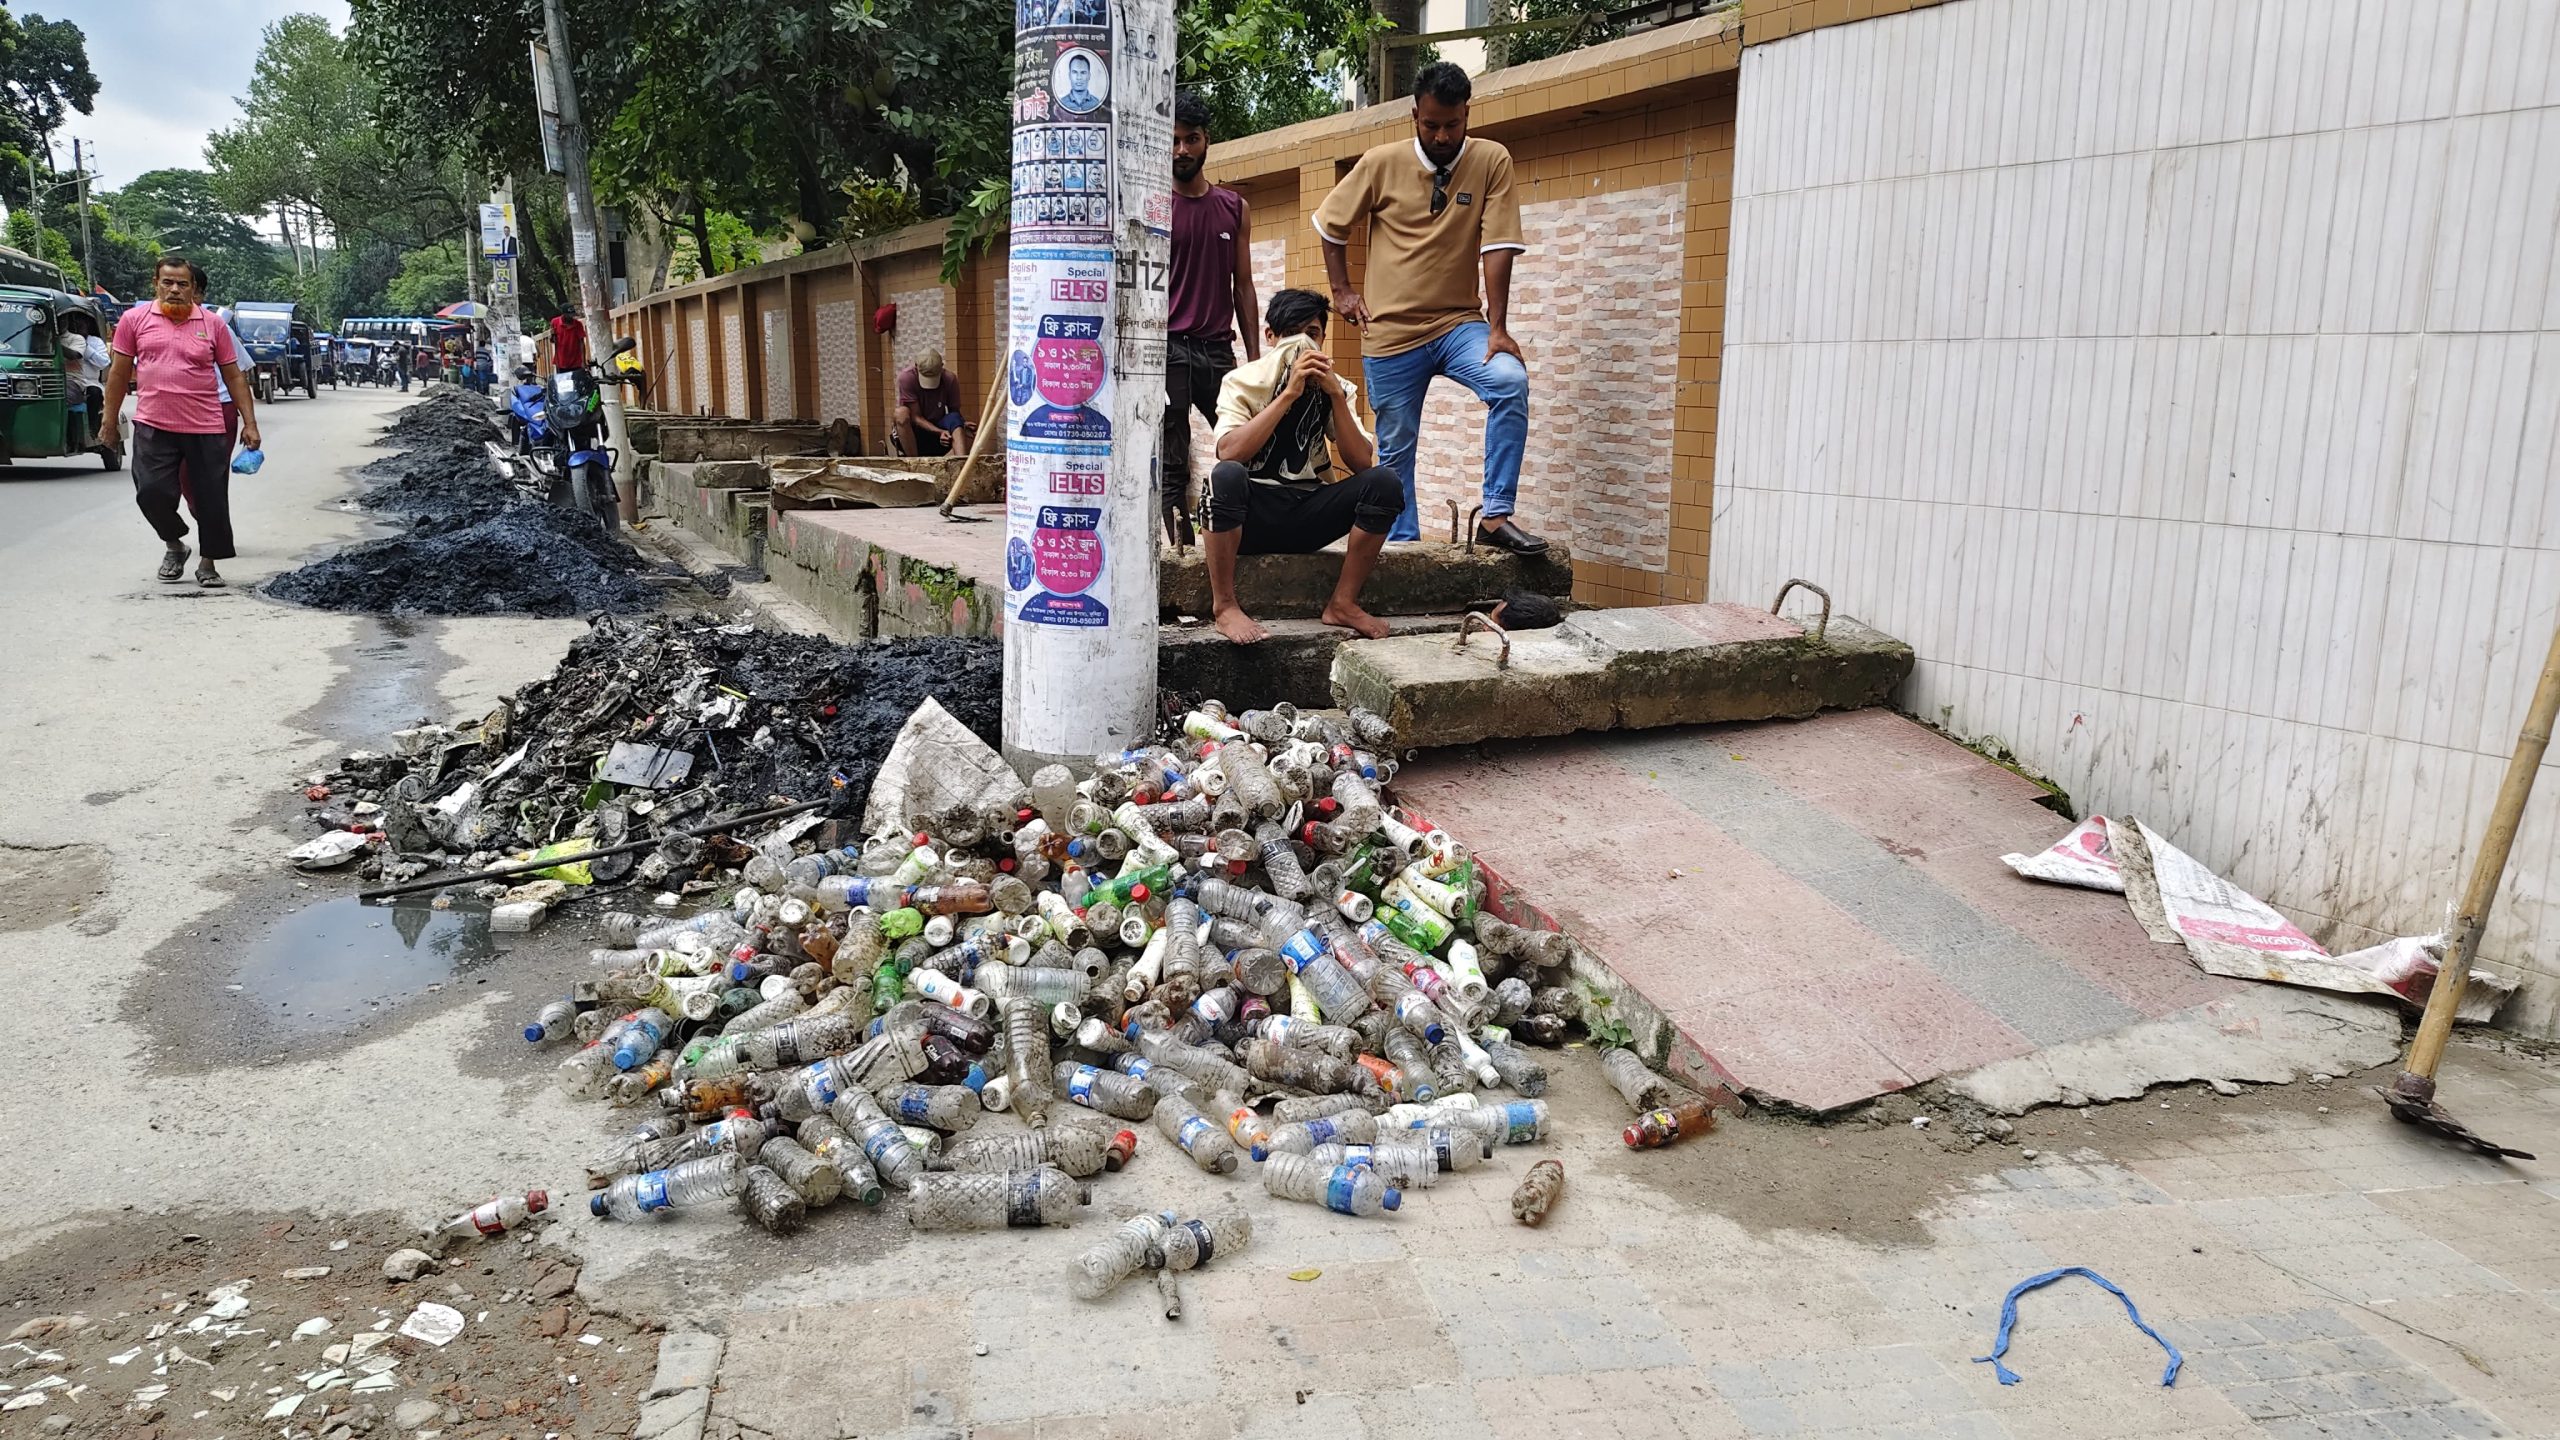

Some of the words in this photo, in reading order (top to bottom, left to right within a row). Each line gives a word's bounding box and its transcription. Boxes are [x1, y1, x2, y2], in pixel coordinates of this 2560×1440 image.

[1023, 87, 1050, 120] চাই
[1011, 263, 1037, 274] English
[1068, 267, 1105, 278] Special
[1052, 280, 1105, 301] IELTS
[1043, 317, 1060, 336] ফ্রি
[1062, 348, 1077, 361] ১২
[1008, 452, 1036, 465] English
[1066, 461, 1103, 472] Special
[1051, 475, 1104, 494] IELTS
[1042, 508, 1059, 527] ফ্রি
[1078, 539, 1098, 553] জুন
